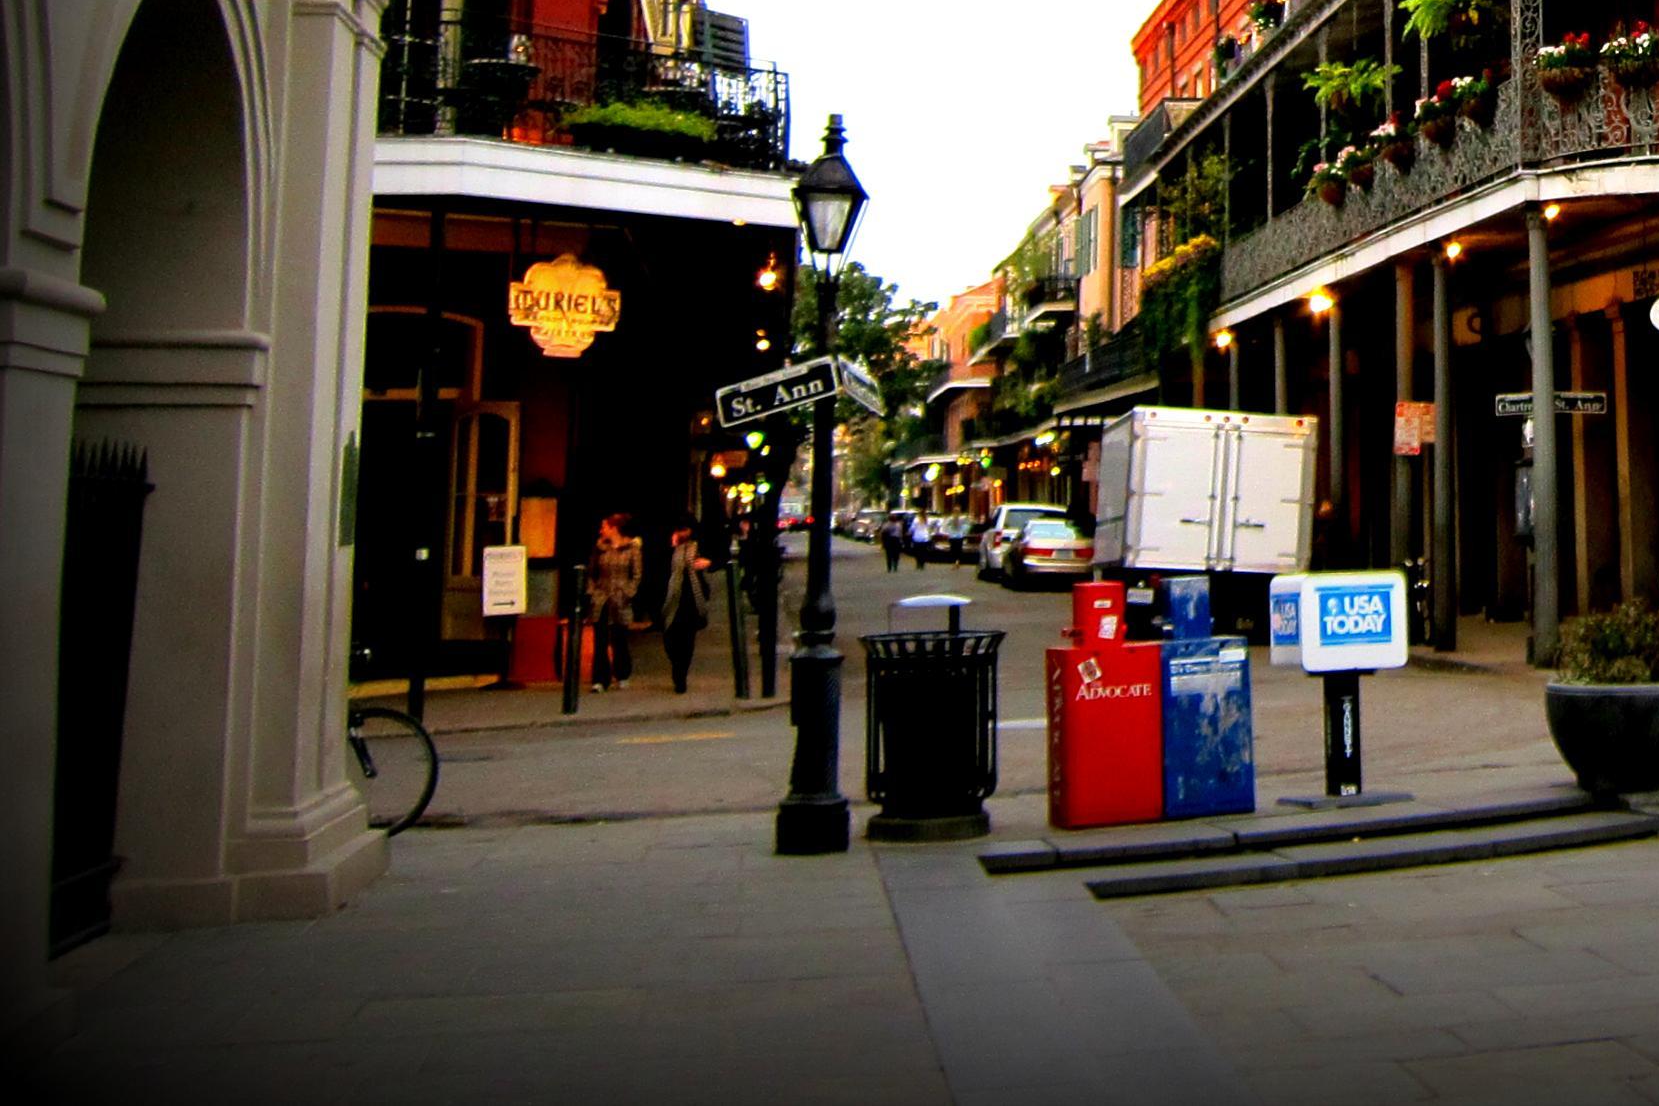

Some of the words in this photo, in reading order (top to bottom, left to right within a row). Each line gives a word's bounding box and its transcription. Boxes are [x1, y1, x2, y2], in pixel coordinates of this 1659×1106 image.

[513, 290, 617, 325] MURIEL'S
[731, 396, 762, 417] St.
[773, 379, 824, 405] Ann
[1498, 401, 1533, 413] Chartre
[1344, 595, 1382, 615] USA
[1323, 613, 1386, 635] TODAY
